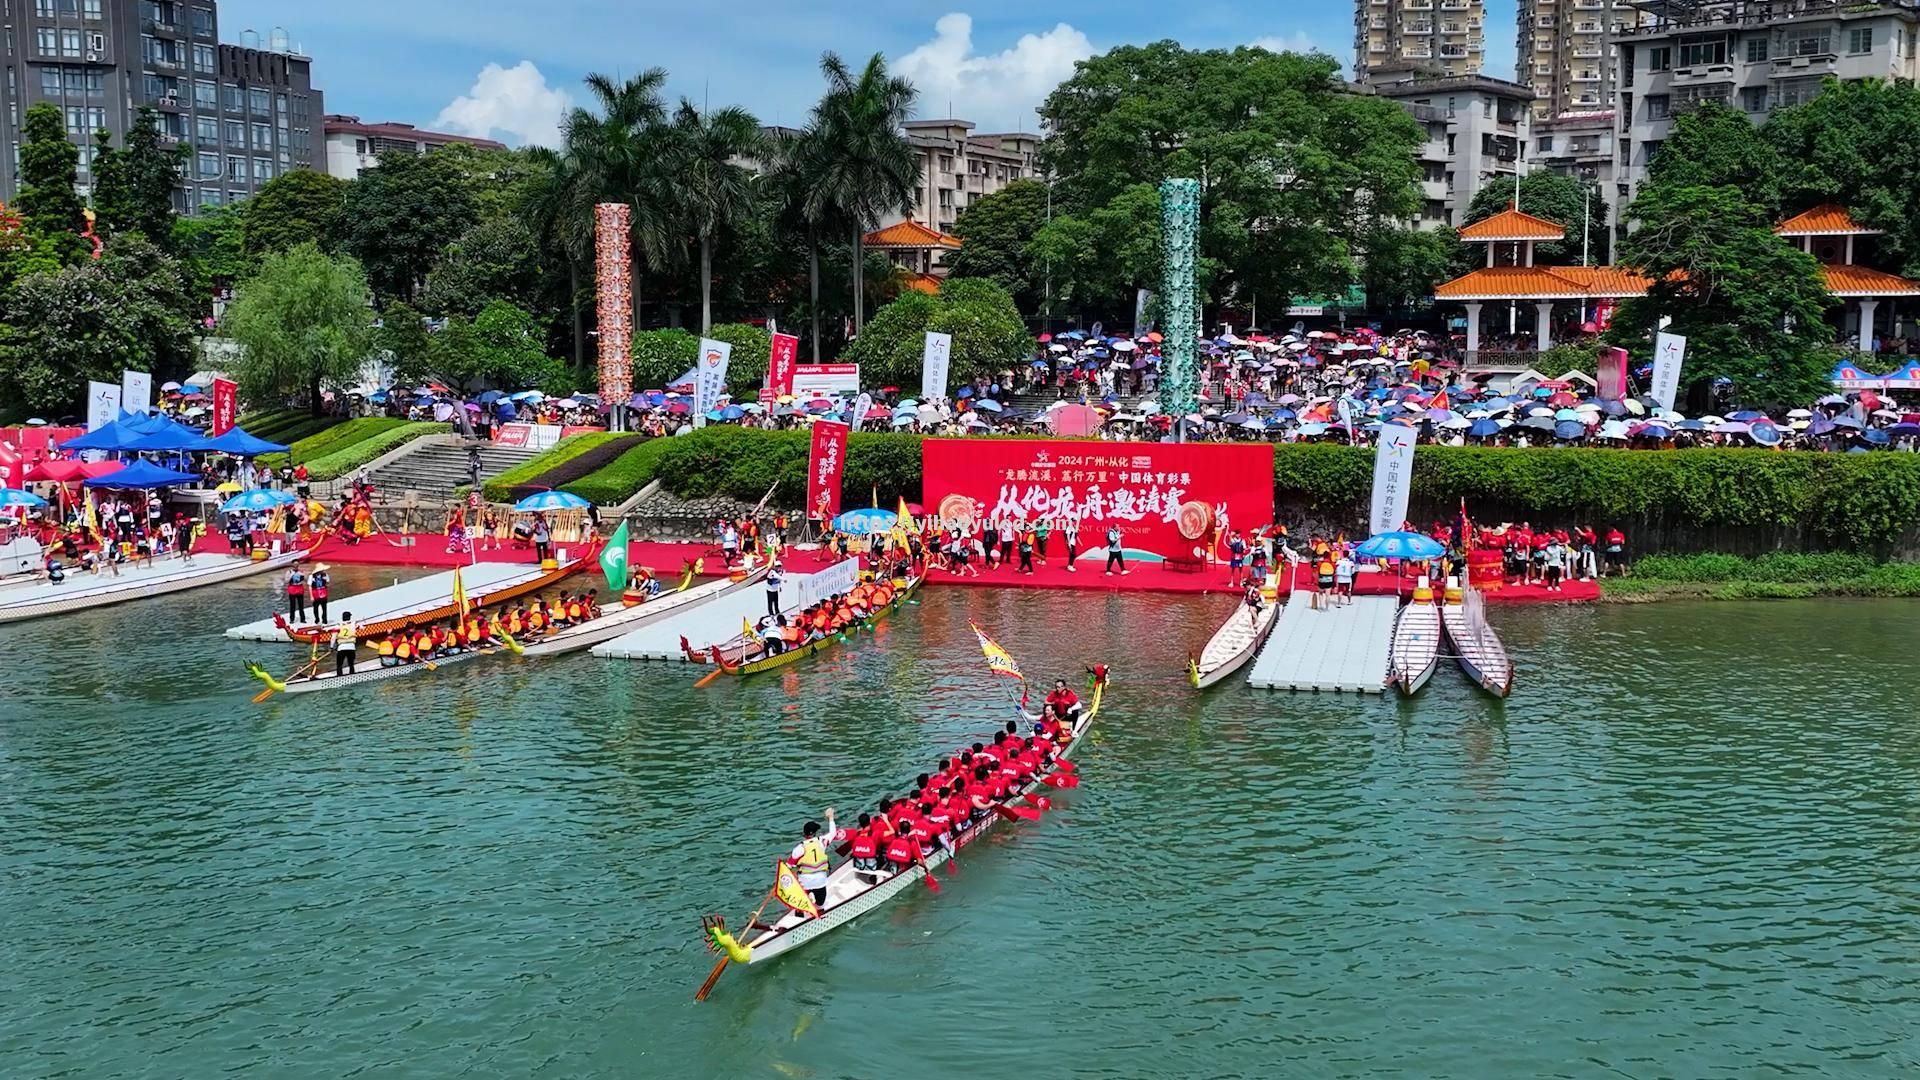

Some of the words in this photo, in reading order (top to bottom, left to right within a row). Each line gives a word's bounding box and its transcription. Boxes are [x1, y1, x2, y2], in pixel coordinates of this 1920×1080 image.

[1058, 456, 1083, 466] 2024
[1084, 456, 1129, 468] 广州·从化
[1118, 471, 1192, 486] 中国体育彩票
[471, 495, 478, 506] 3
[1381, 460, 1400, 529] 中国体育彩票
[990, 484, 1186, 524] 从化龙舟邀请赛
[467, 527, 474, 536] 3
[769, 535, 776, 544] 2
[811, 848, 818, 862] 1
